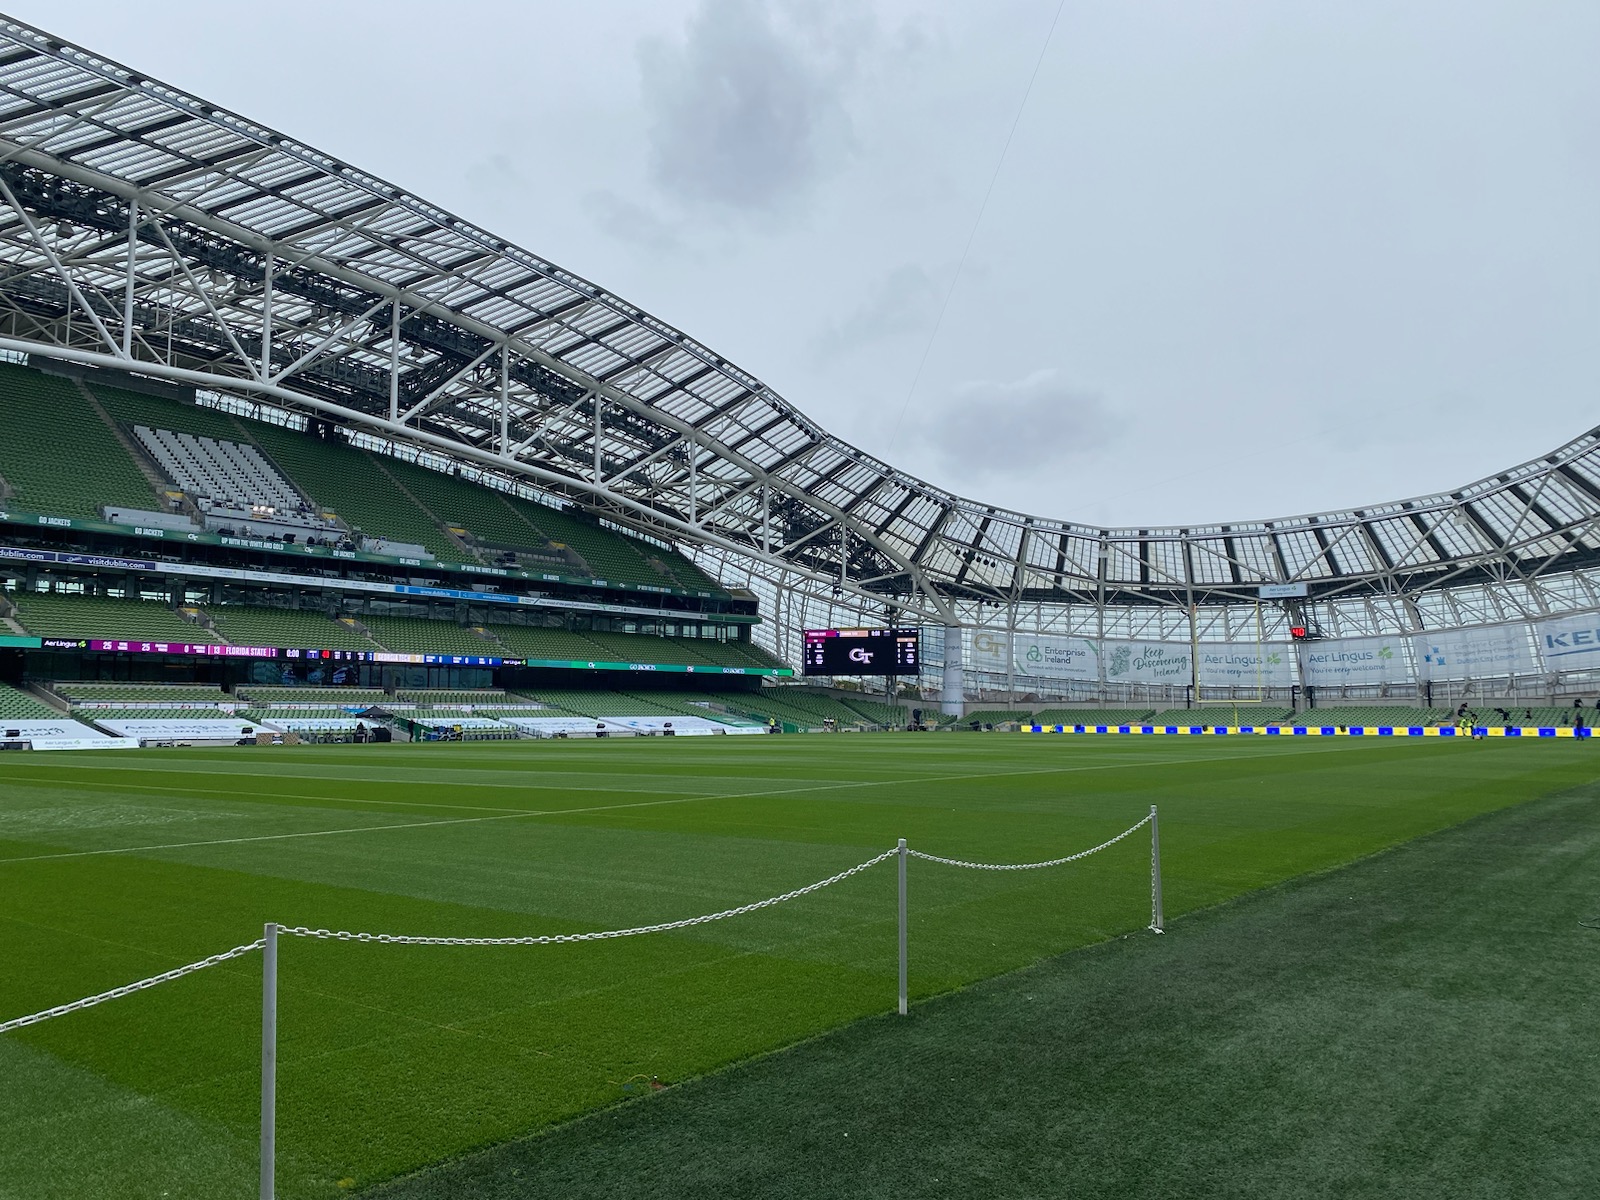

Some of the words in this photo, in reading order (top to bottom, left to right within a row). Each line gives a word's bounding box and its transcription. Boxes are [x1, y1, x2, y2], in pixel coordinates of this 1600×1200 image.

[38, 516, 47, 524] GO
[47, 517, 71, 527] JACKETS
[88, 557, 146, 569] visitdublin.com
[1292, 628, 1305, 637] 40
[56, 640, 77, 648] Lingus
[102, 642, 112, 650] 25
[142, 643, 150, 652] 25
[184, 645, 190, 653] 0
[226, 646, 250, 656] FLORIDA
[250, 648, 266, 656] STATE
[286, 650, 300, 658] 0:00
[848, 648, 874, 664] GT
[1045, 646, 1086, 657] Enterprise
[1144, 645, 1164, 660] Keep
[1044, 655, 1070, 664] Ireland
[1204, 655, 1224, 664] Aer
[1225, 655, 1262, 667] Lingus
[1309, 654, 1330, 663] Aer
[1332, 651, 1374, 664] Lingus
[1132, 656, 1190, 670] Discovering
[1154, 666, 1180, 678] Ireland
[1227, 669, 1242, 678] very
